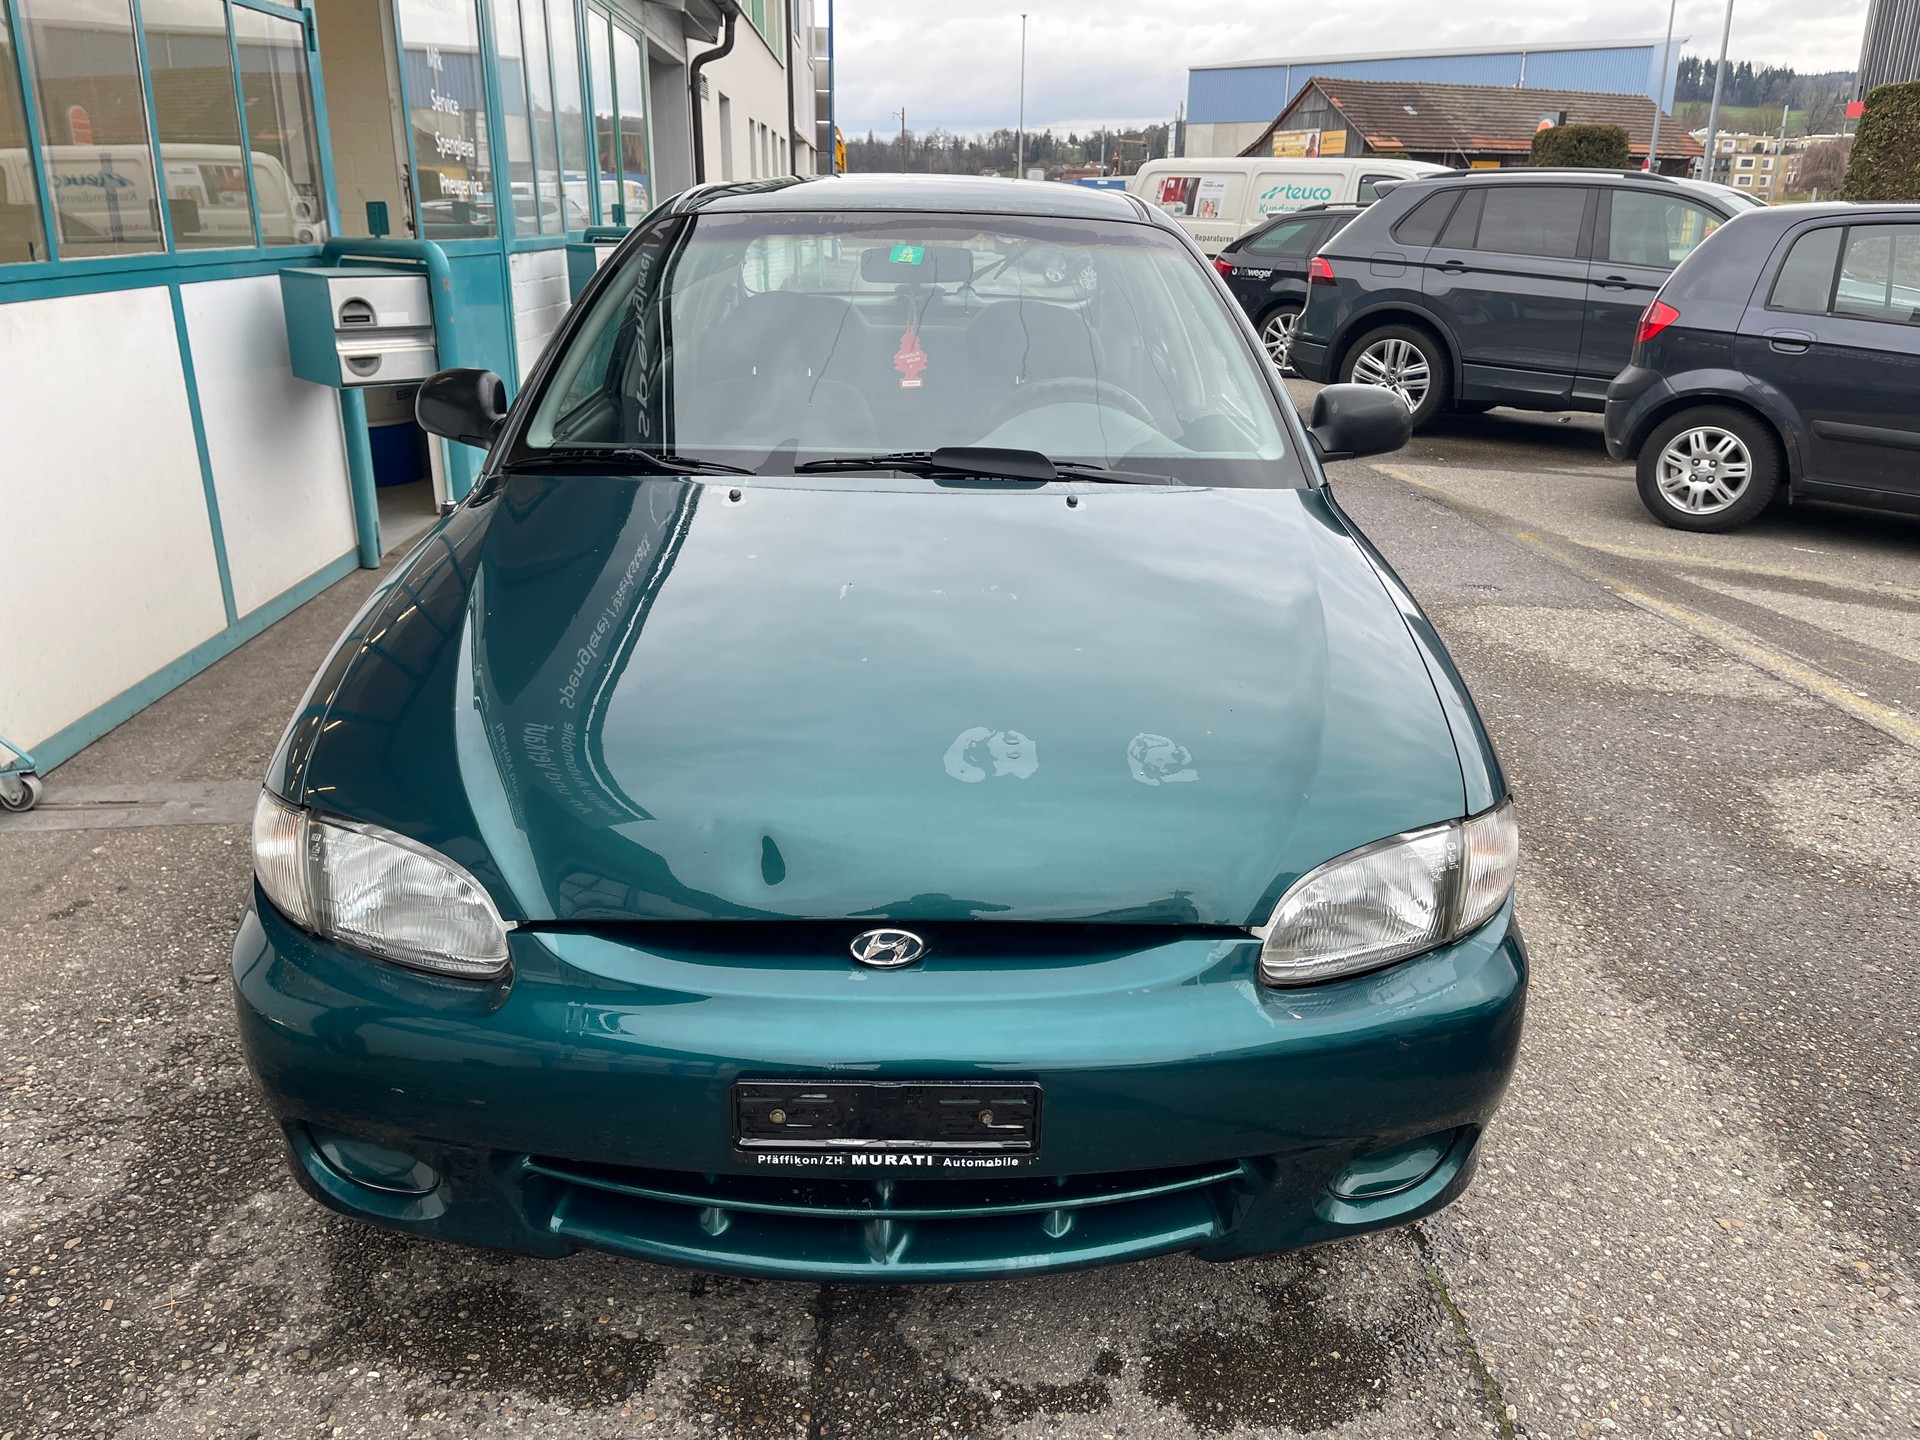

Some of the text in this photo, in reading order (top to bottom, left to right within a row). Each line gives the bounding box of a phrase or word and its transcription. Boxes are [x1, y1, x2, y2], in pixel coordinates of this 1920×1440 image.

[430, 88, 460, 116] Service
[434, 131, 475, 161] Spenglerei
[439, 172, 484, 196] Pneuservice
[1285, 183, 1332, 201] teuco
[1194, 233, 1234, 244] Reparaturen
[757, 1154, 1019, 1167] Pfäffikon/ZH MURATI Automobile
